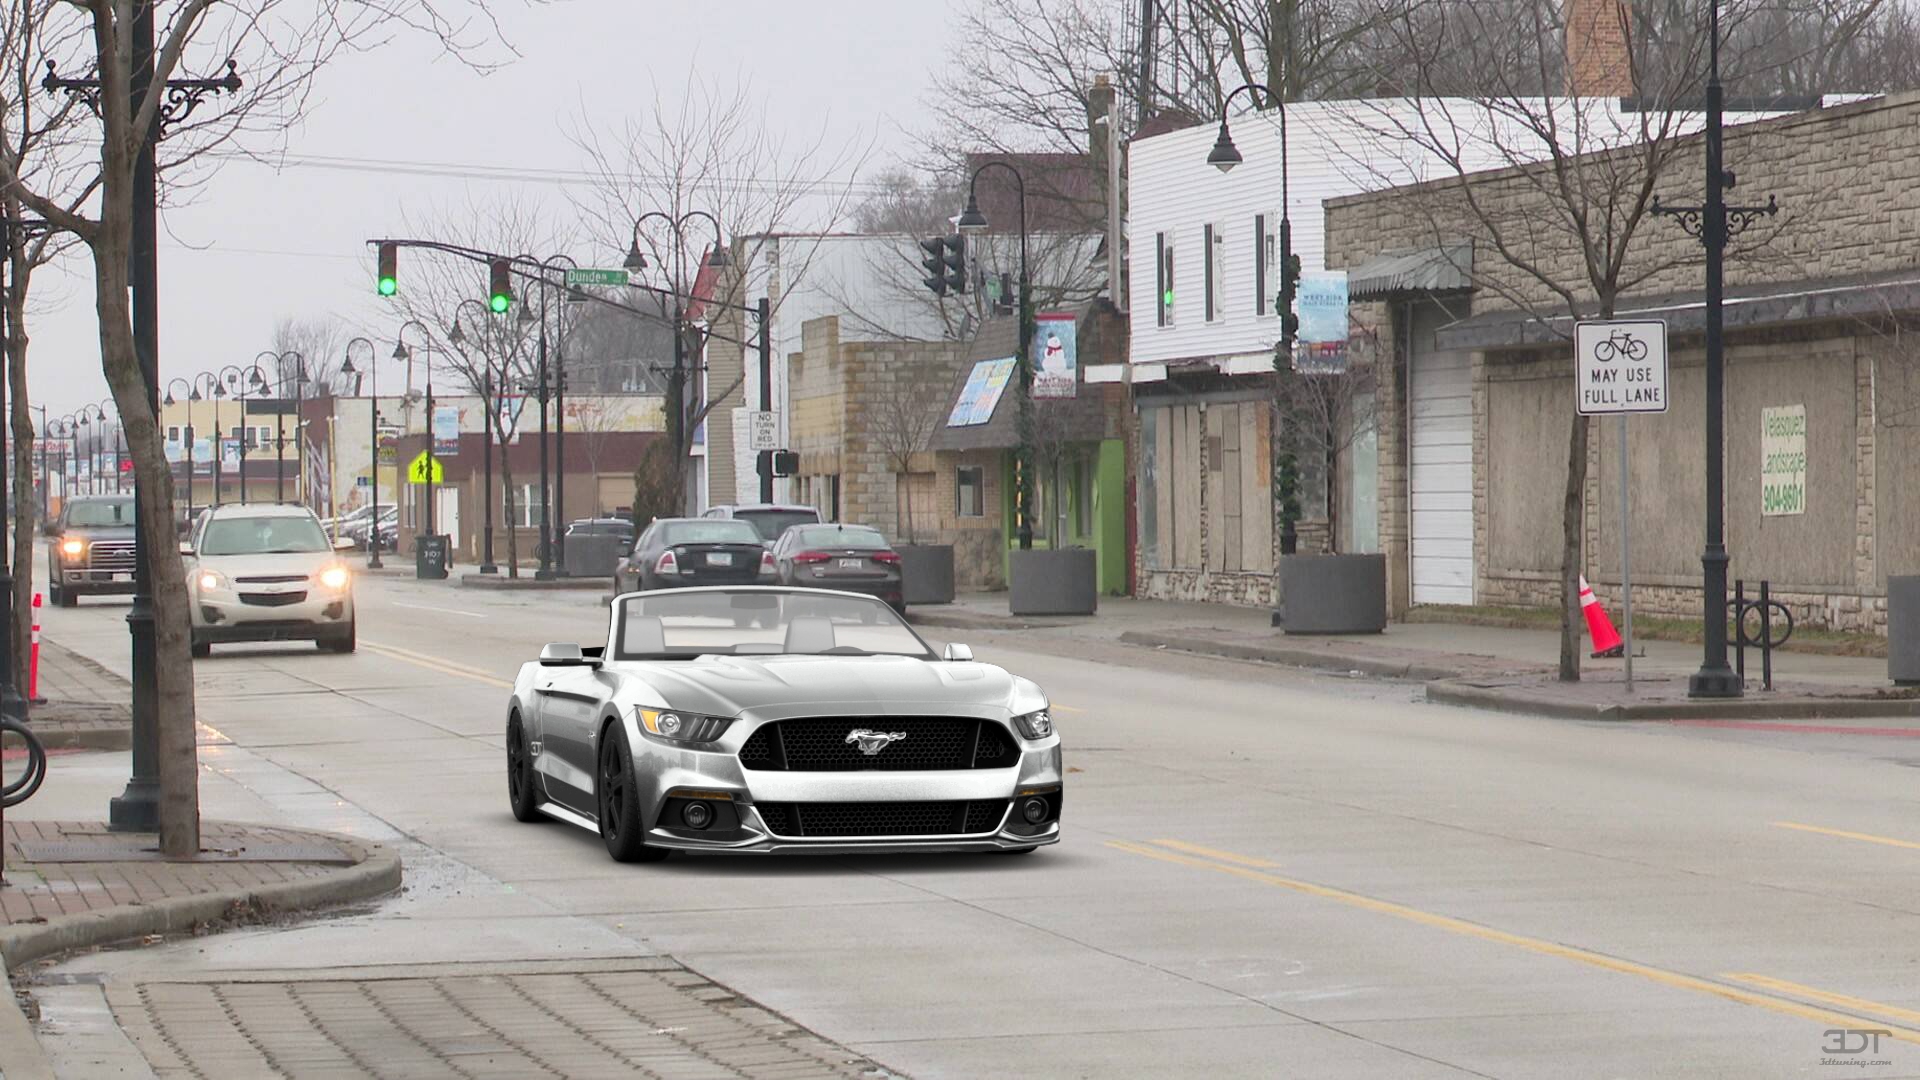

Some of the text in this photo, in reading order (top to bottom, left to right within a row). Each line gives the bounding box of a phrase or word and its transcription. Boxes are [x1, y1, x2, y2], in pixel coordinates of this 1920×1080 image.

[1592, 367, 1652, 383] MAY USE
[1585, 387, 1660, 404] FULL LANE
[758, 413, 772, 421] NO
[755, 421, 776, 429] TURN
